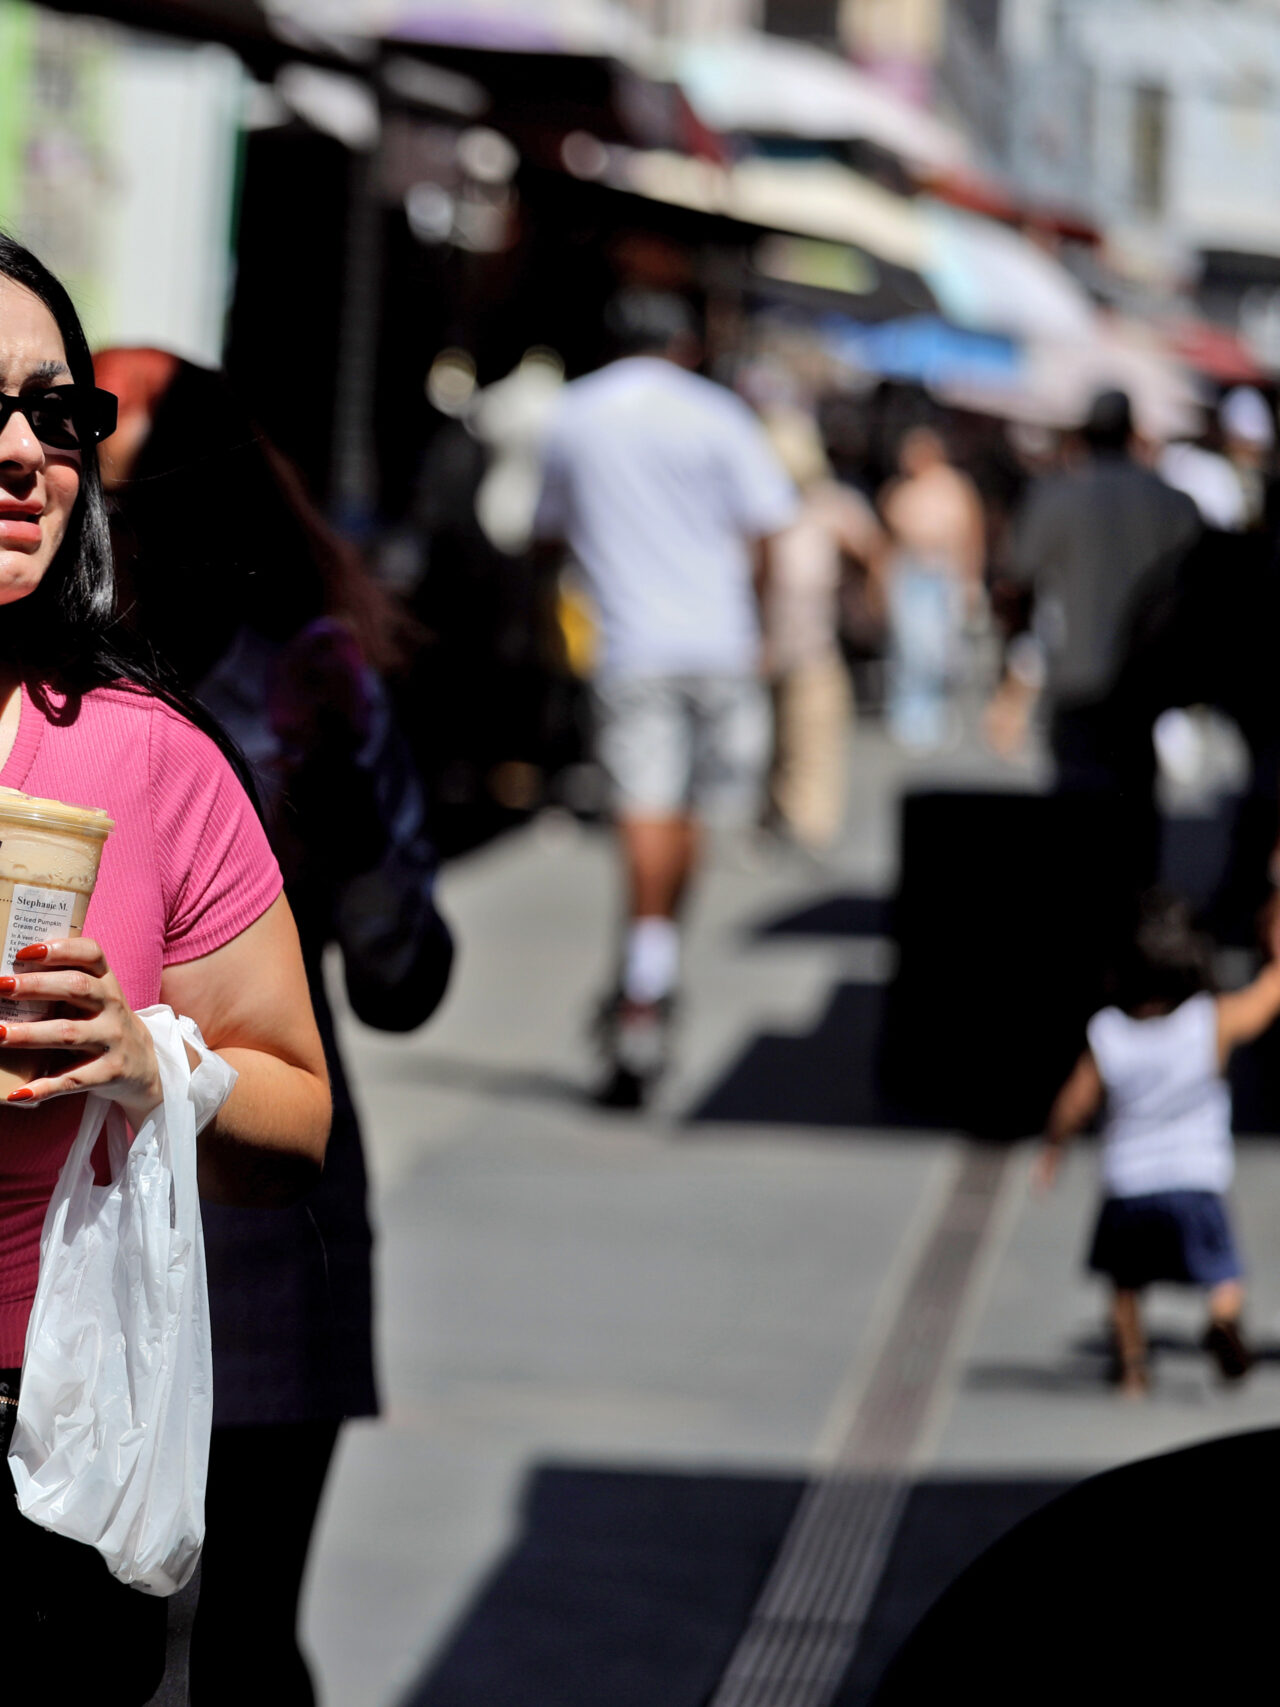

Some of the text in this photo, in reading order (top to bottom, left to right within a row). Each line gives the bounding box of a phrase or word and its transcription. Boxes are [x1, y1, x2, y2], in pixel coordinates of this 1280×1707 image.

[17, 896, 57, 910] Stephanie
[13, 922, 33, 930] Cream
[37, 918, 62, 927] Pumpkin
